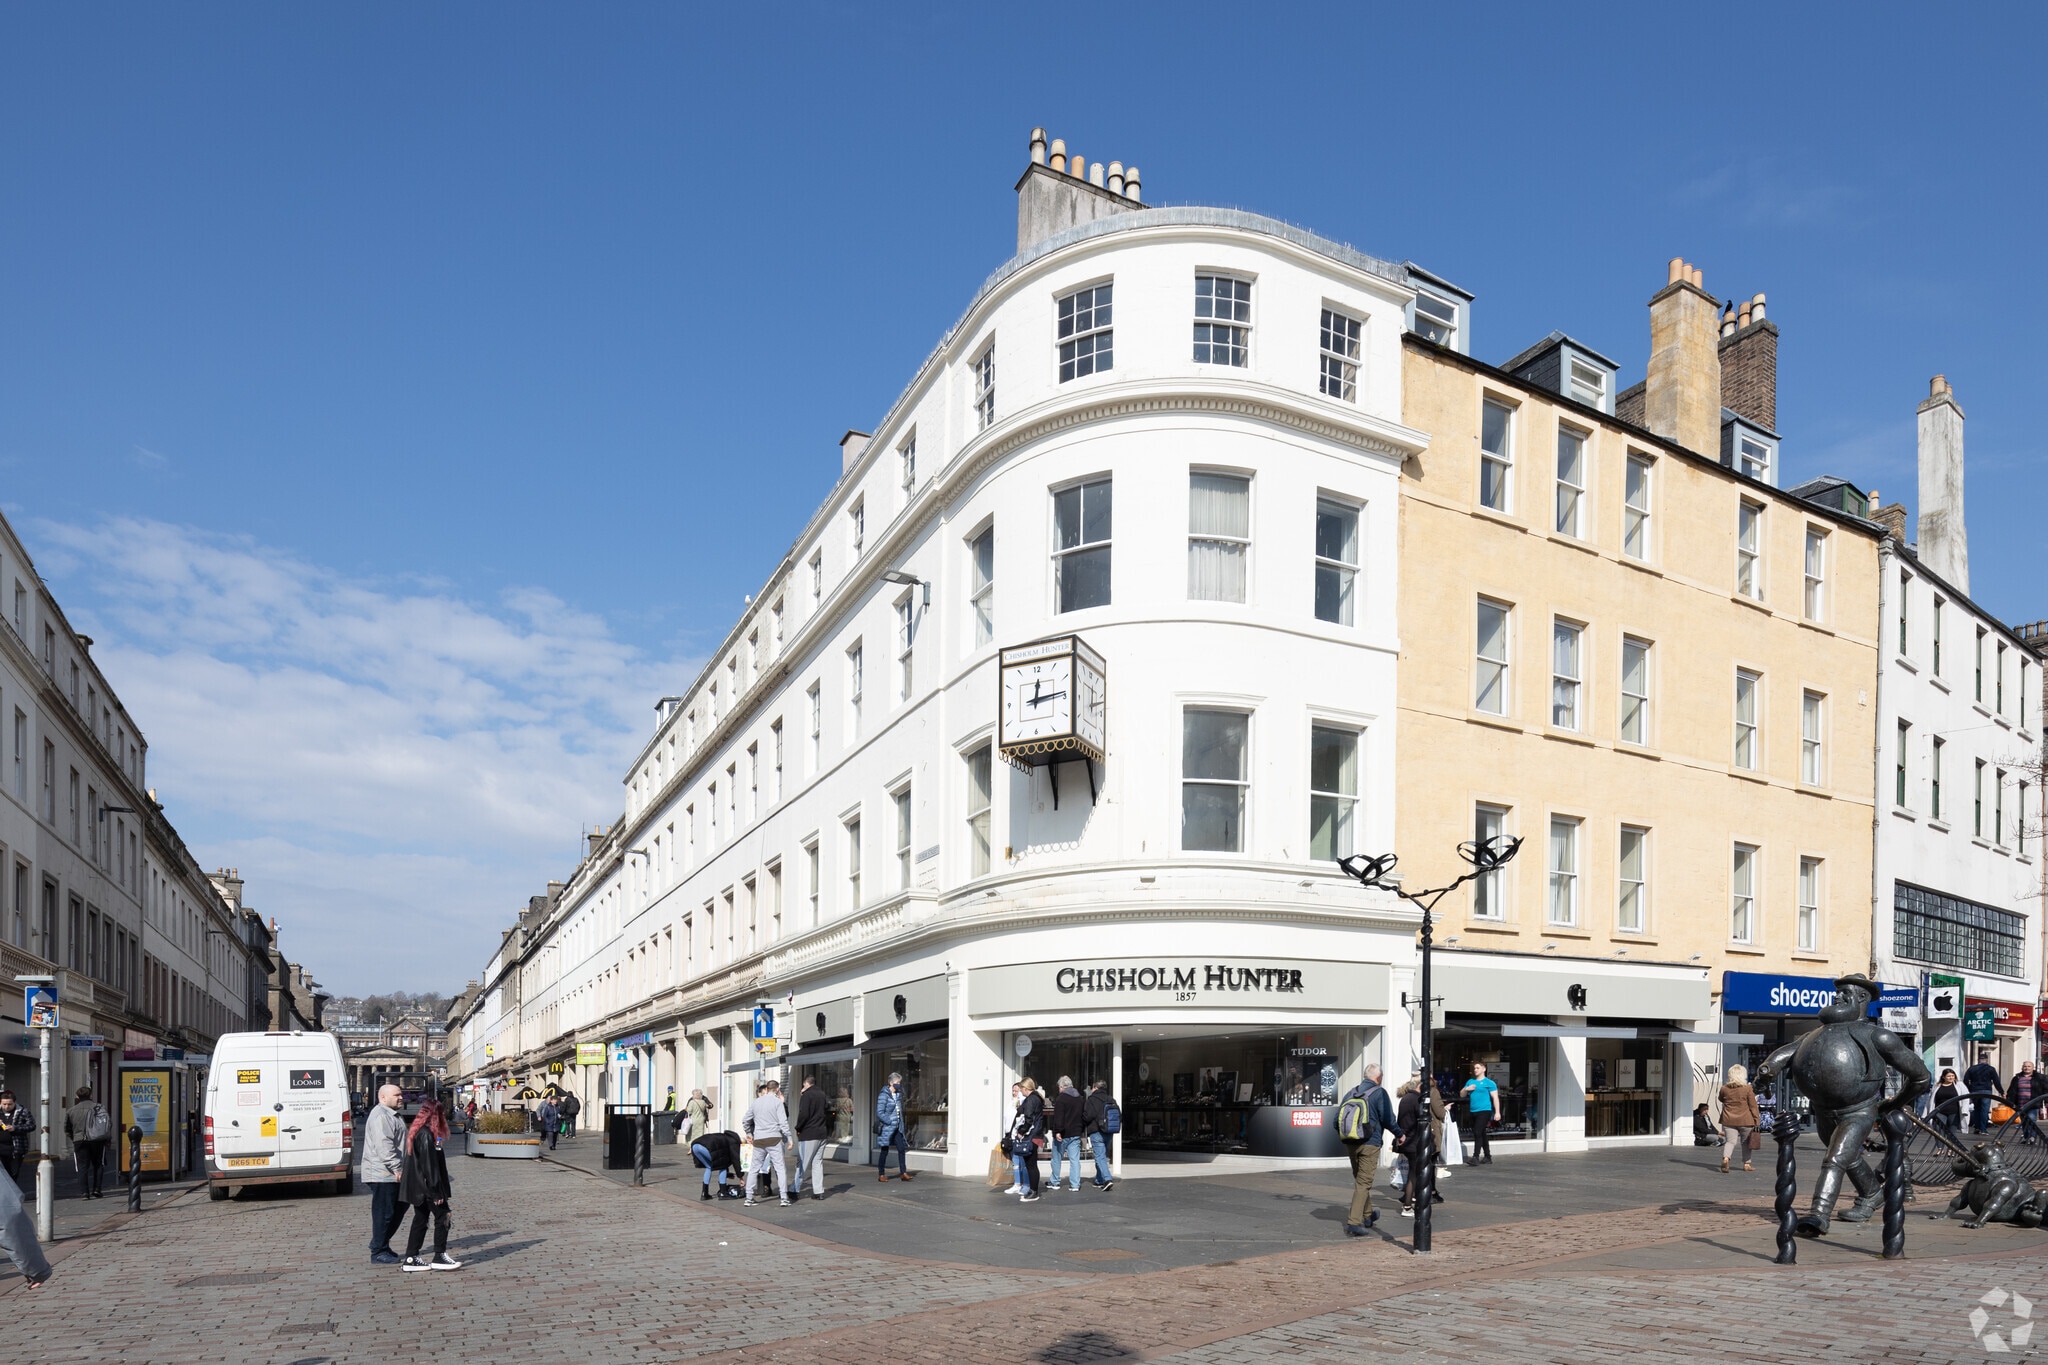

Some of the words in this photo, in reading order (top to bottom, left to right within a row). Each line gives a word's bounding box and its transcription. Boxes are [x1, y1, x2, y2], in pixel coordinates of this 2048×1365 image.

[1056, 967, 1196, 993] CHISHOLM
[1203, 965, 1304, 993] HUNTER
[1175, 992, 1197, 1001] 1857
[1291, 1048, 1327, 1056] TUDOR
[129, 1085, 162, 1094] WAKEY
[129, 1094, 162, 1103] WAKEY
[1293, 1111, 1322, 1119] #BORN
